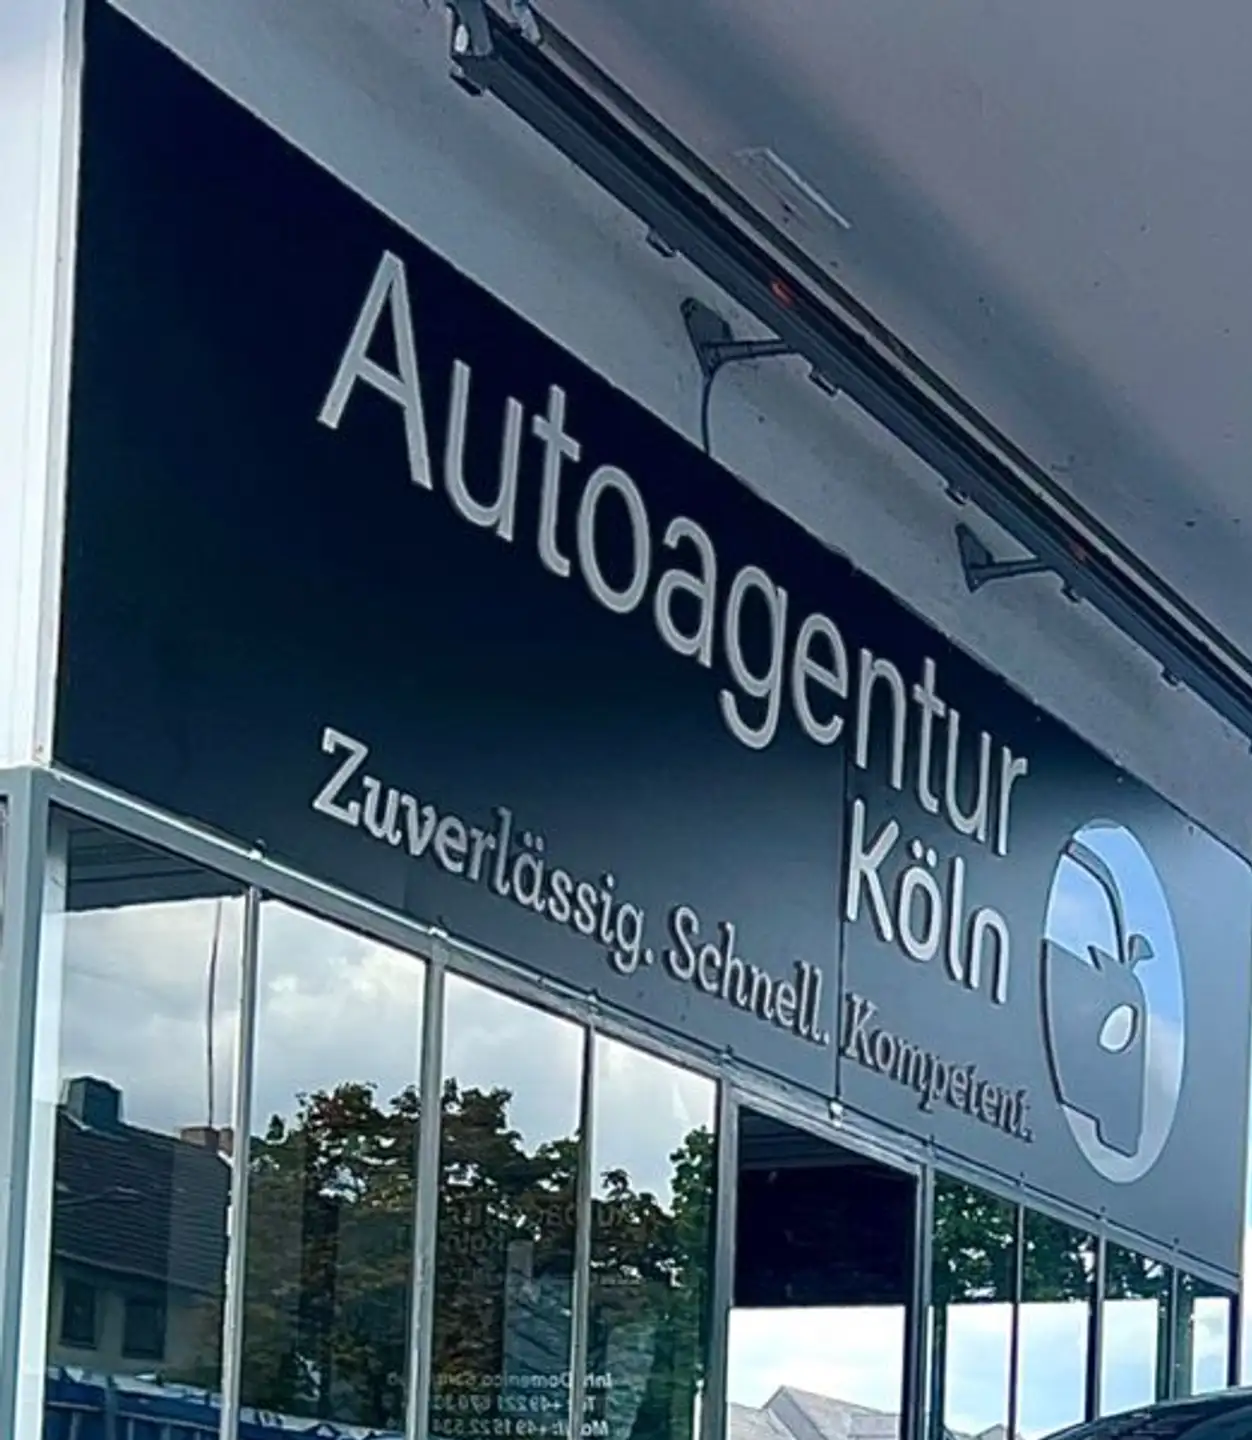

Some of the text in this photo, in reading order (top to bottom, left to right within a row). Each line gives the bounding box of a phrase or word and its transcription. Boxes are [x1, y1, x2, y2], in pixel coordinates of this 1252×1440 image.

[317, 249, 1027, 856] Autoagentur
[313, 726, 1034, 1142] Zuverlässig. Schnell. Kompetent.
[845, 798, 1010, 1004] Köln
